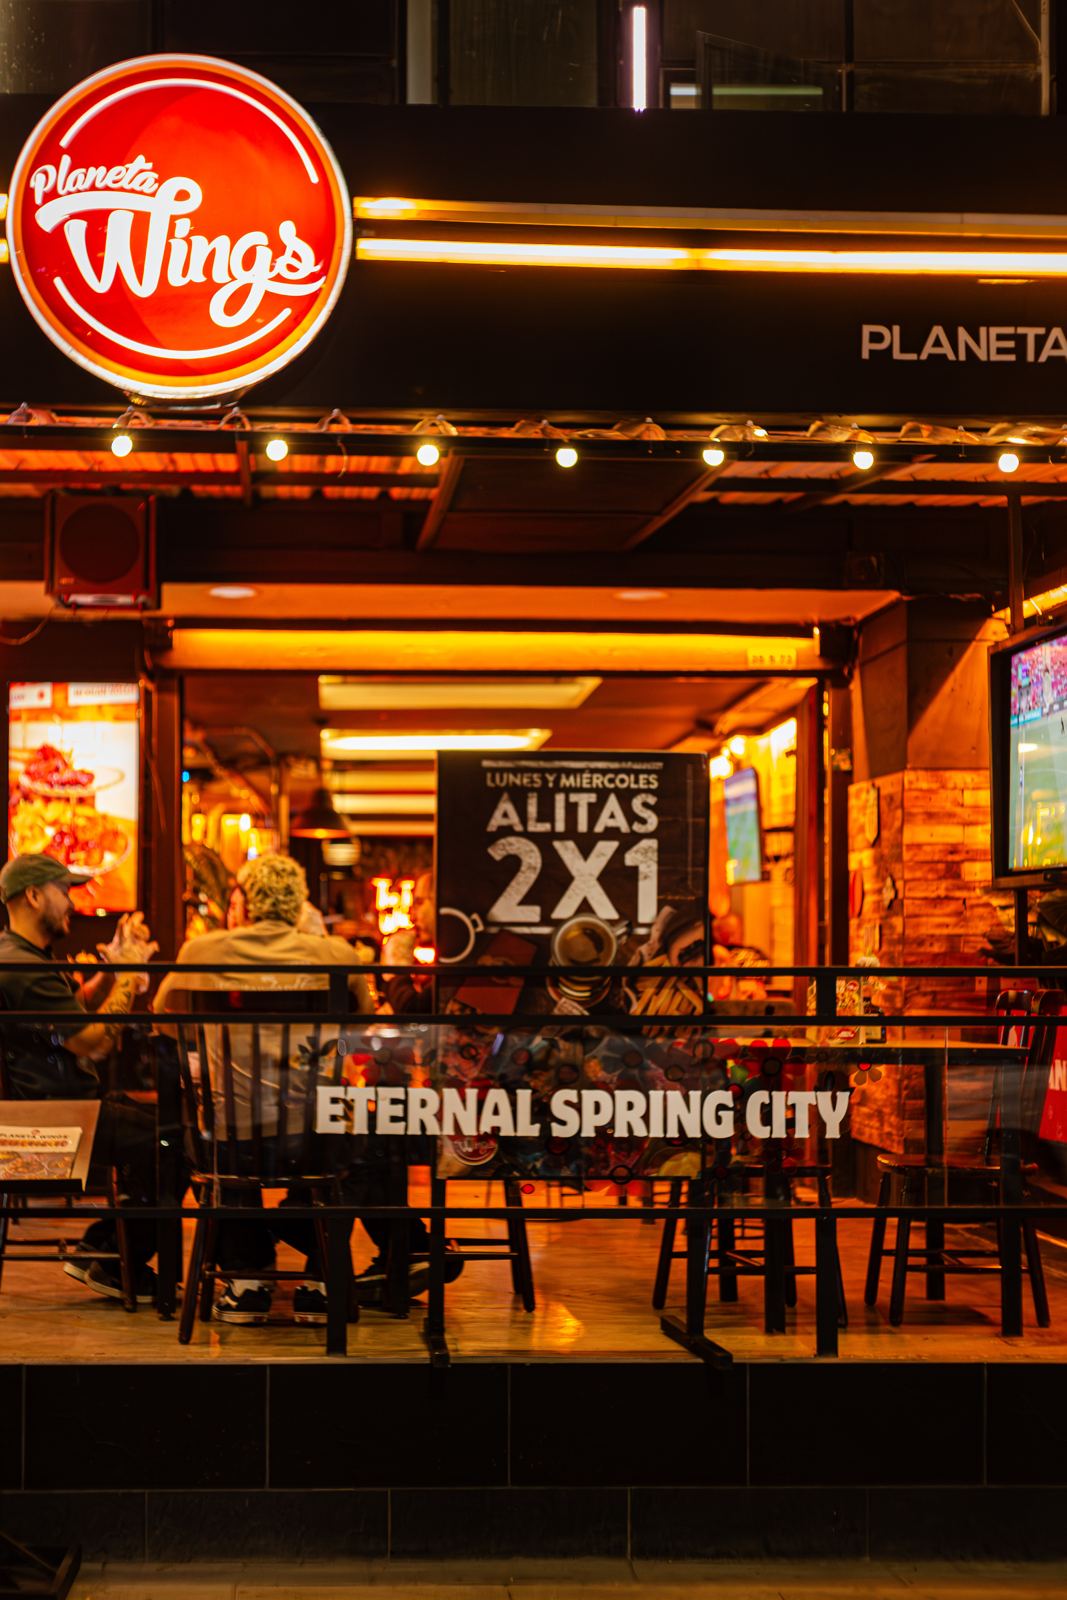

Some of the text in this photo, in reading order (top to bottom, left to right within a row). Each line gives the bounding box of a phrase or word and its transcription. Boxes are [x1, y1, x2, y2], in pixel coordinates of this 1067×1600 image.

[35, 177, 326, 328] Wings
[861, 324, 1067, 363] PLANETA
[486, 769, 659, 789] LUNES Y MIÉRCOLES
[486, 792, 659, 834] ALITAS
[487, 836, 659, 924] 2X1
[315, 1086, 851, 1140] ETERNAL SPRING CITY
